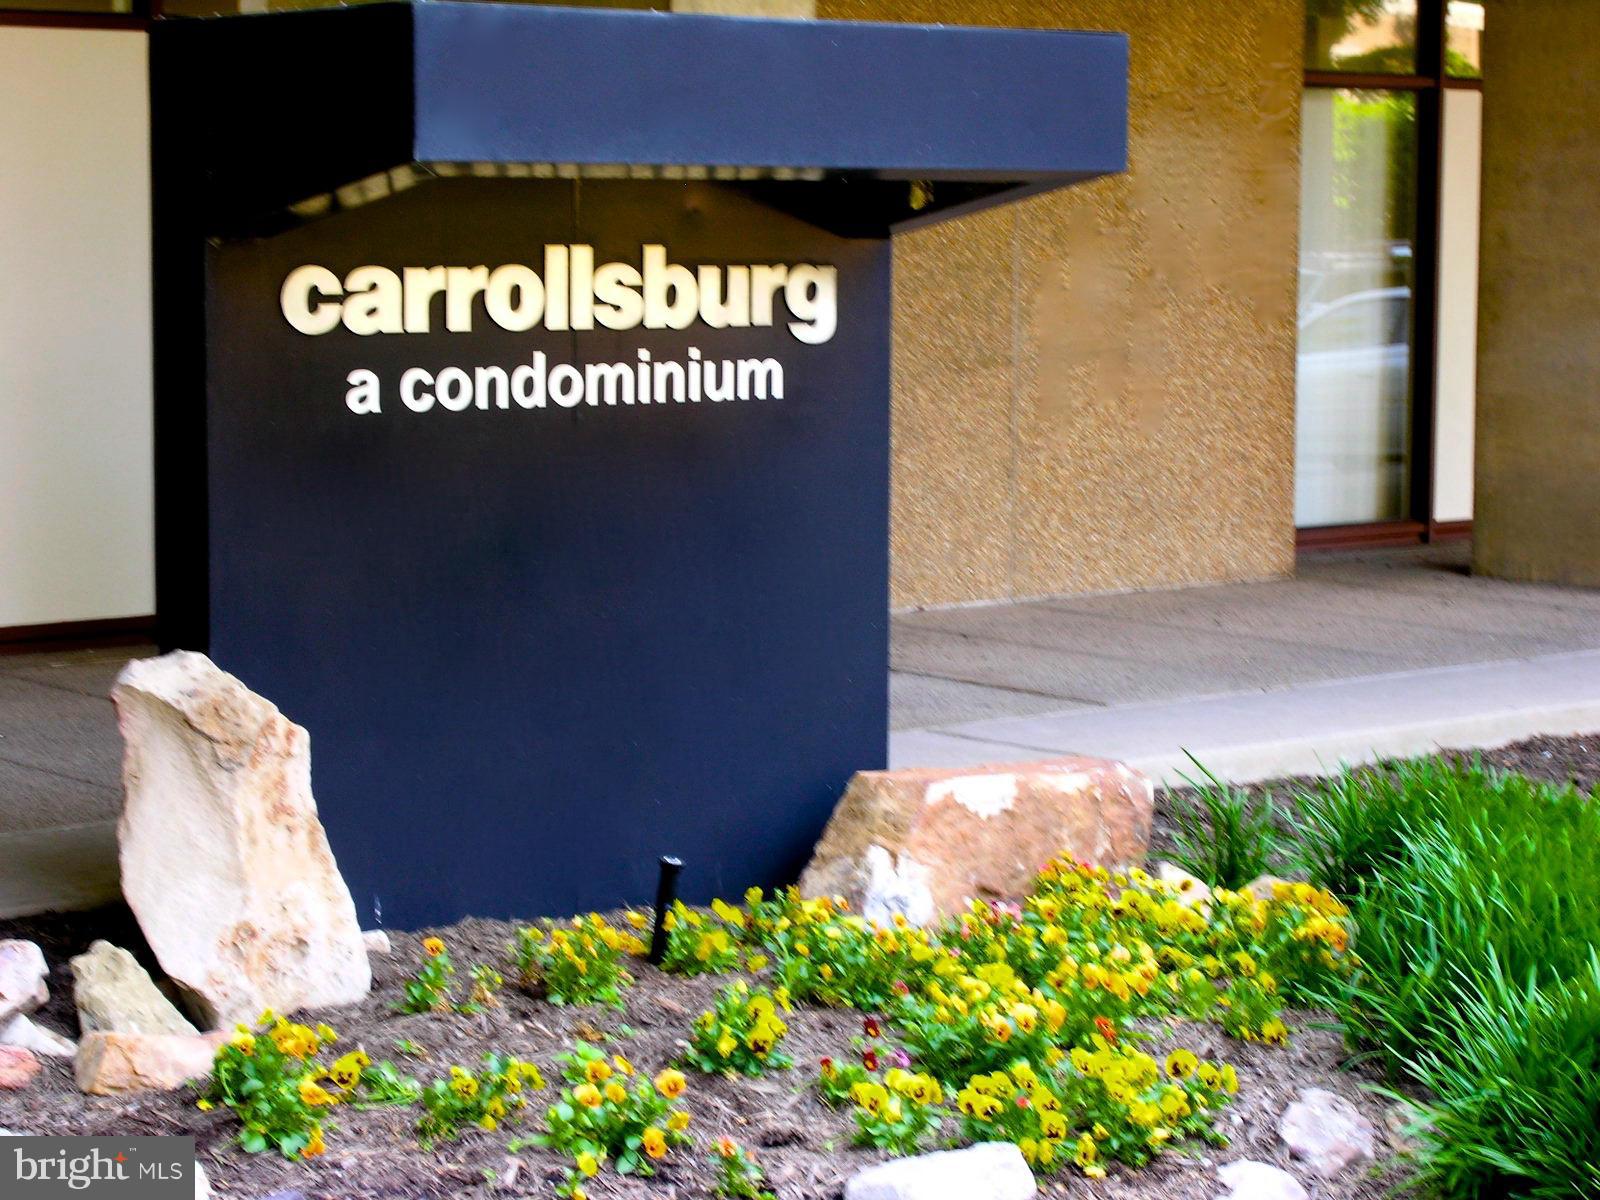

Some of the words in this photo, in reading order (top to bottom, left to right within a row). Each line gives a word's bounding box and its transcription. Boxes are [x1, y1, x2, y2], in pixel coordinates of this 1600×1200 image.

[280, 243, 838, 345] carrollsburg
[345, 368, 382, 415] a
[399, 346, 784, 413] condominium
